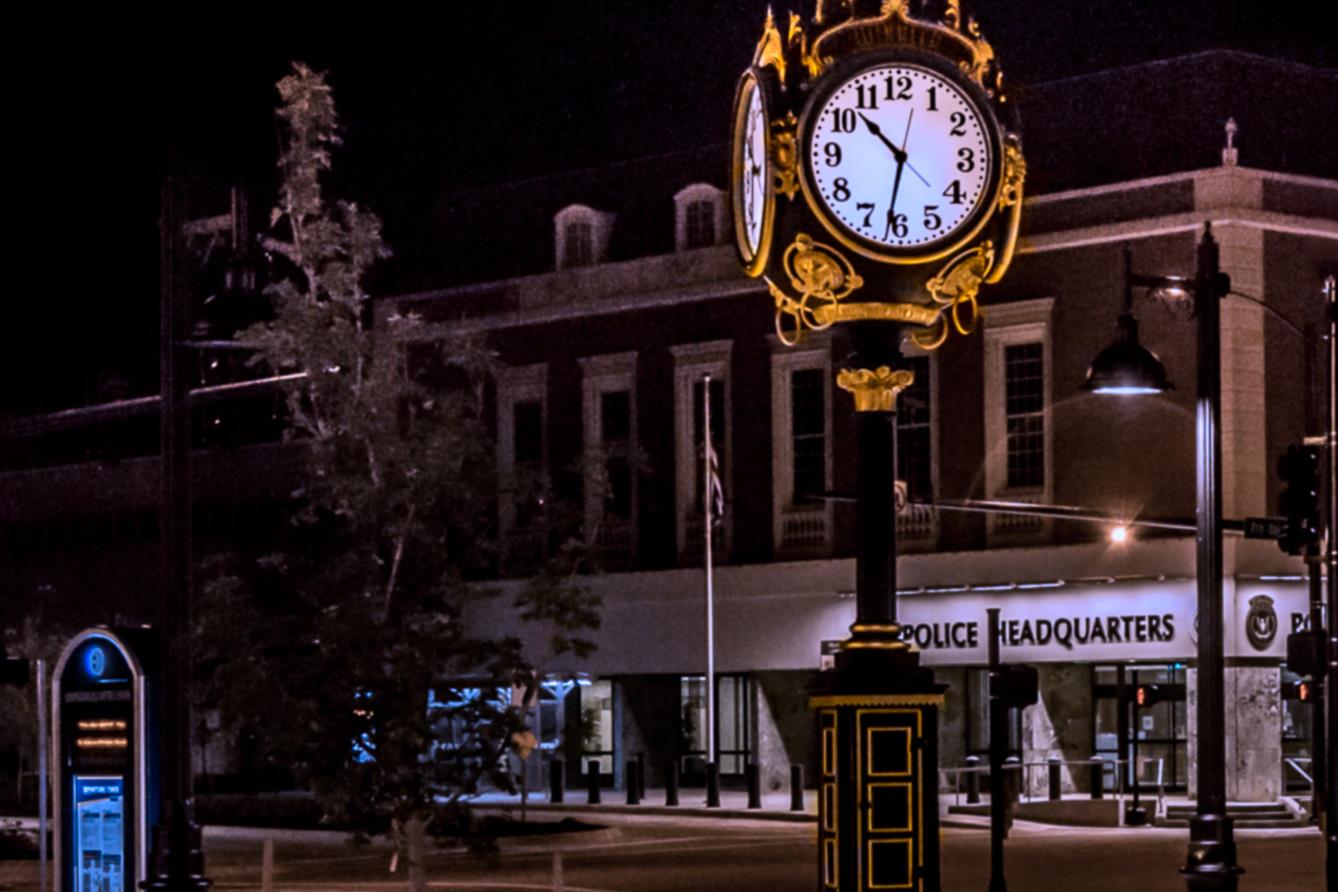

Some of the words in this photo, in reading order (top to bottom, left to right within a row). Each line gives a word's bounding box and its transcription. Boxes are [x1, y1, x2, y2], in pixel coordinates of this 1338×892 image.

[855, 85, 879, 110] 11
[883, 76, 913, 101] 12
[926, 87, 939, 112] 1
[831, 108, 857, 134] 10
[950, 112, 967, 137] 2
[823, 142, 842, 167] 9
[957, 148, 975, 173] 3
[832, 178, 851, 203] 8
[942, 180, 967, 205] 4
[856, 203, 875, 228] 7
[892, 214, 909, 238] 6
[923, 206, 942, 230] 5
[903, 621, 979, 649] POLICE
